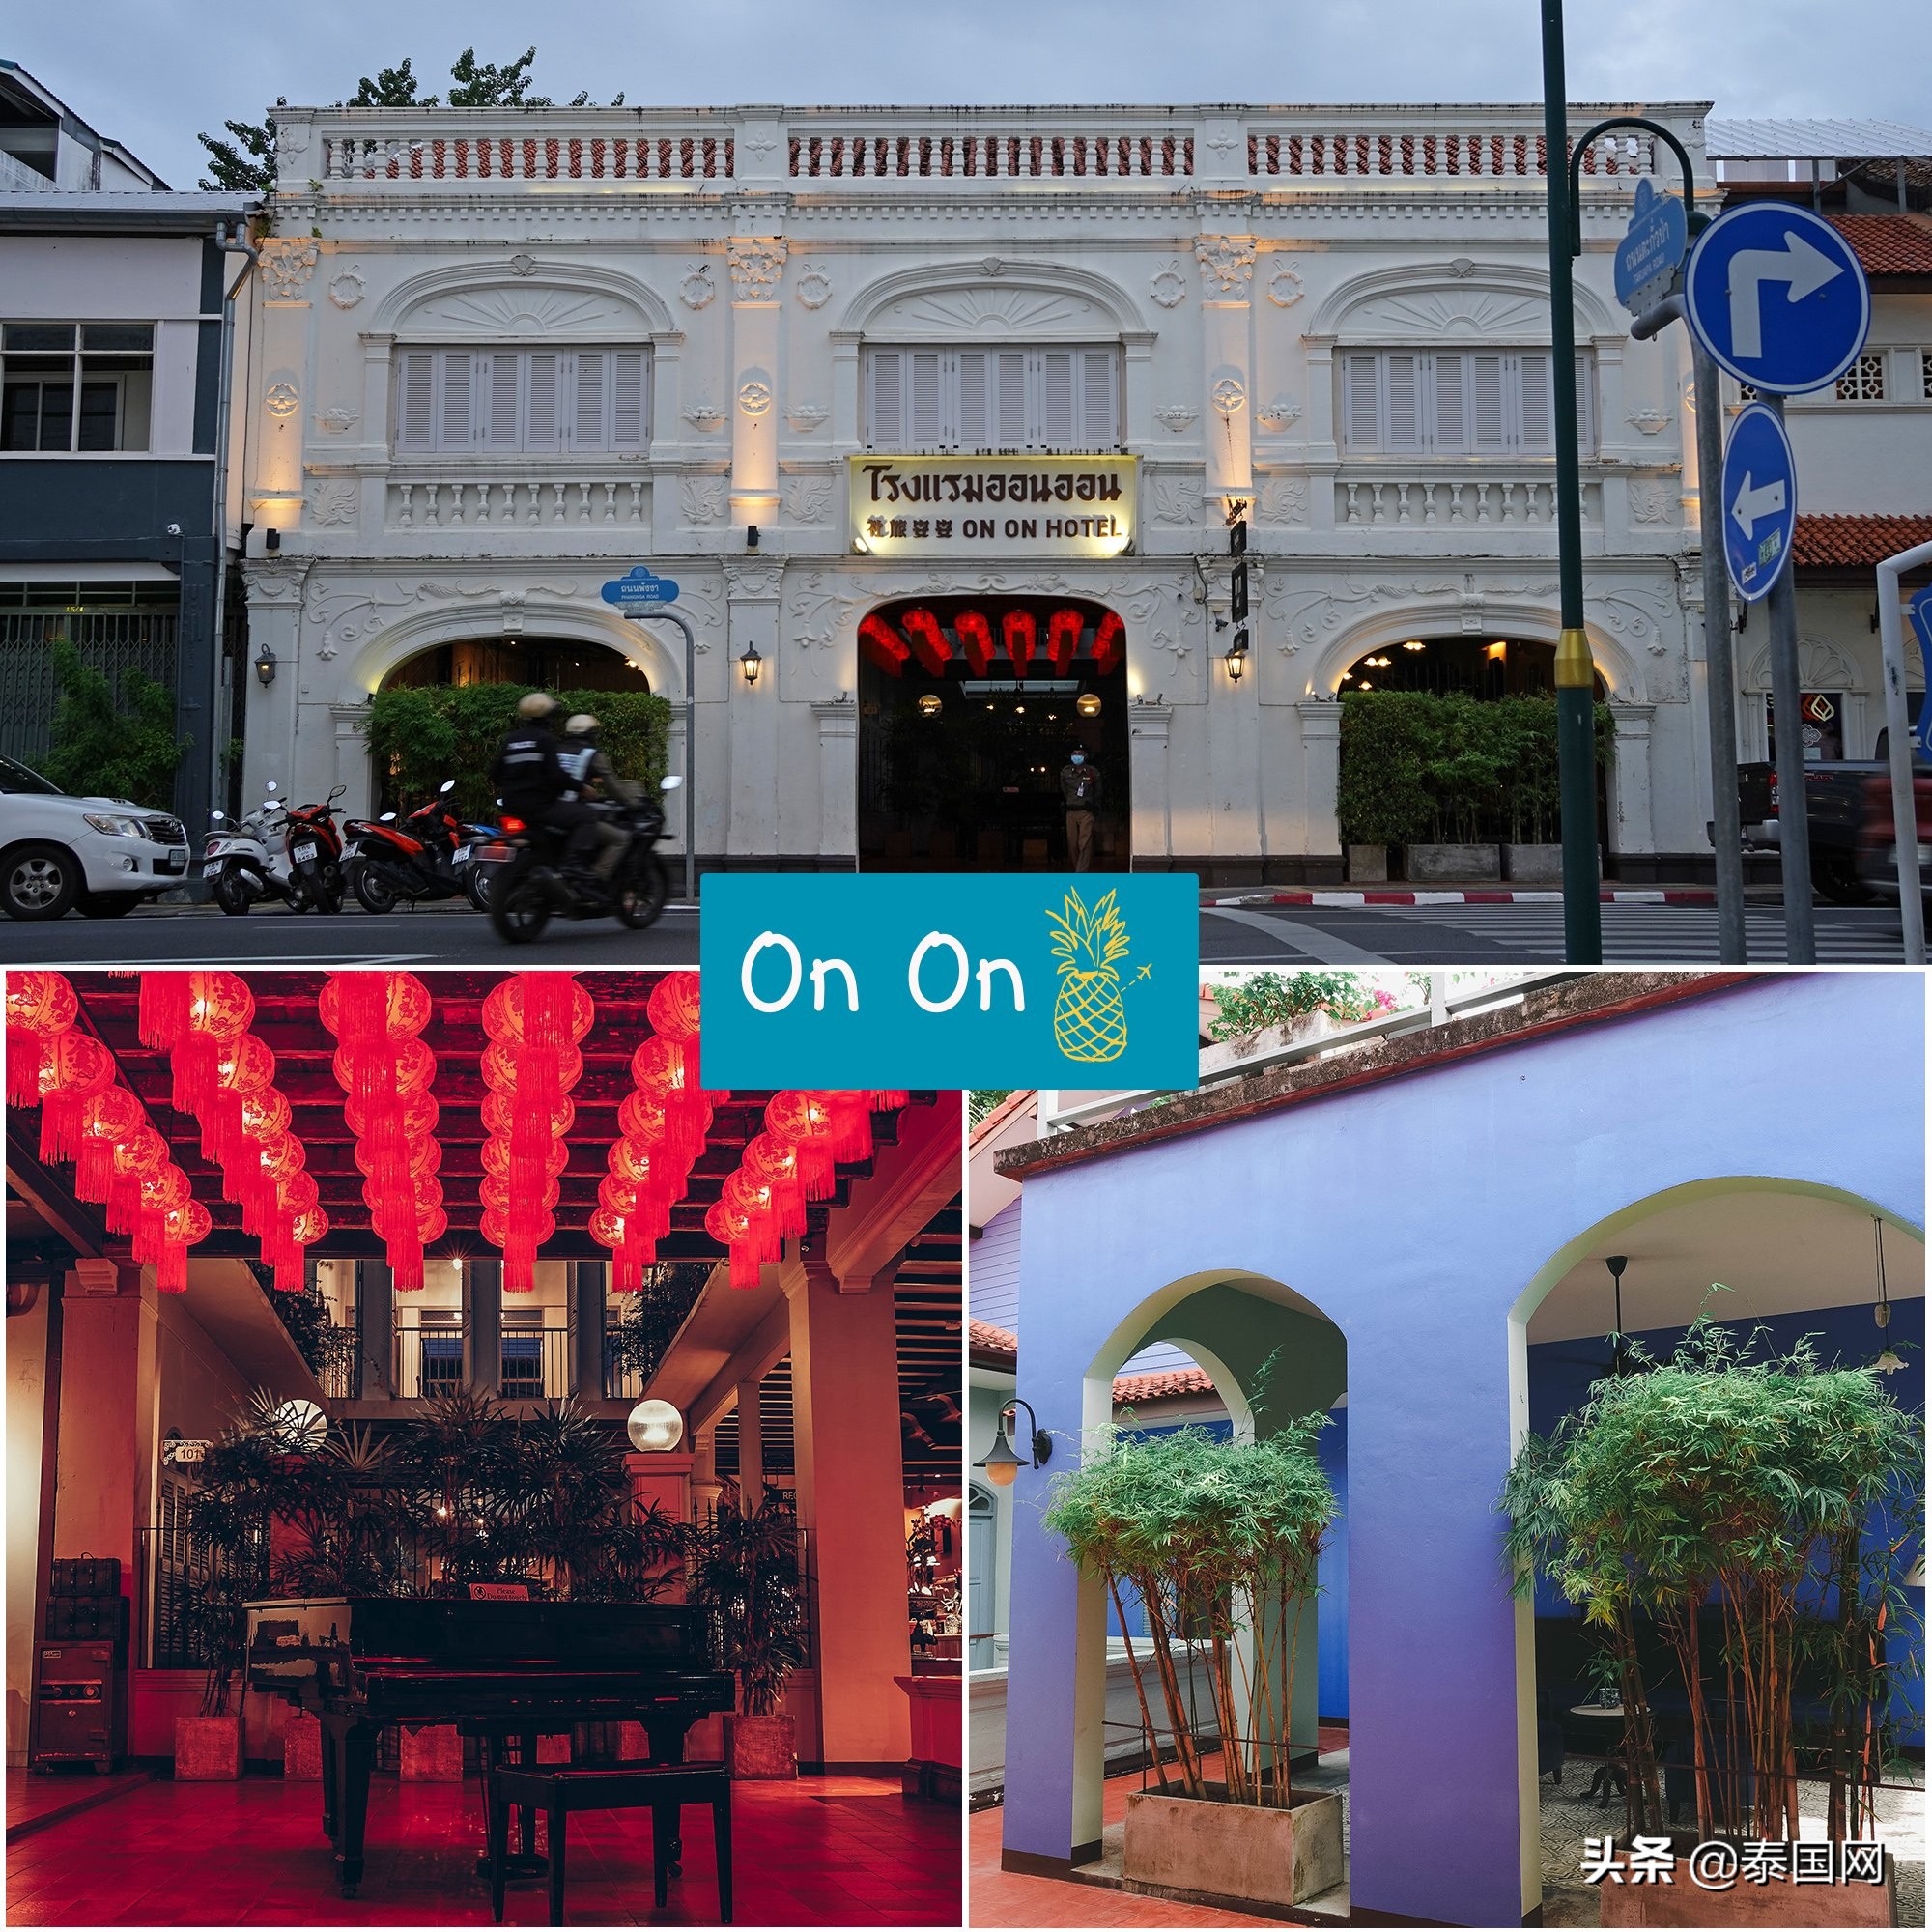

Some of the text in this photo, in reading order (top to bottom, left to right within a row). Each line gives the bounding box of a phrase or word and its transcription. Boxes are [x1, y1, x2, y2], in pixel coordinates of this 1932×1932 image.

[862, 464, 1122, 503] โรงแรมออนออน
[962, 518, 1122, 539] ON ON HOTEL
[181, 1448, 199, 1459] 101
